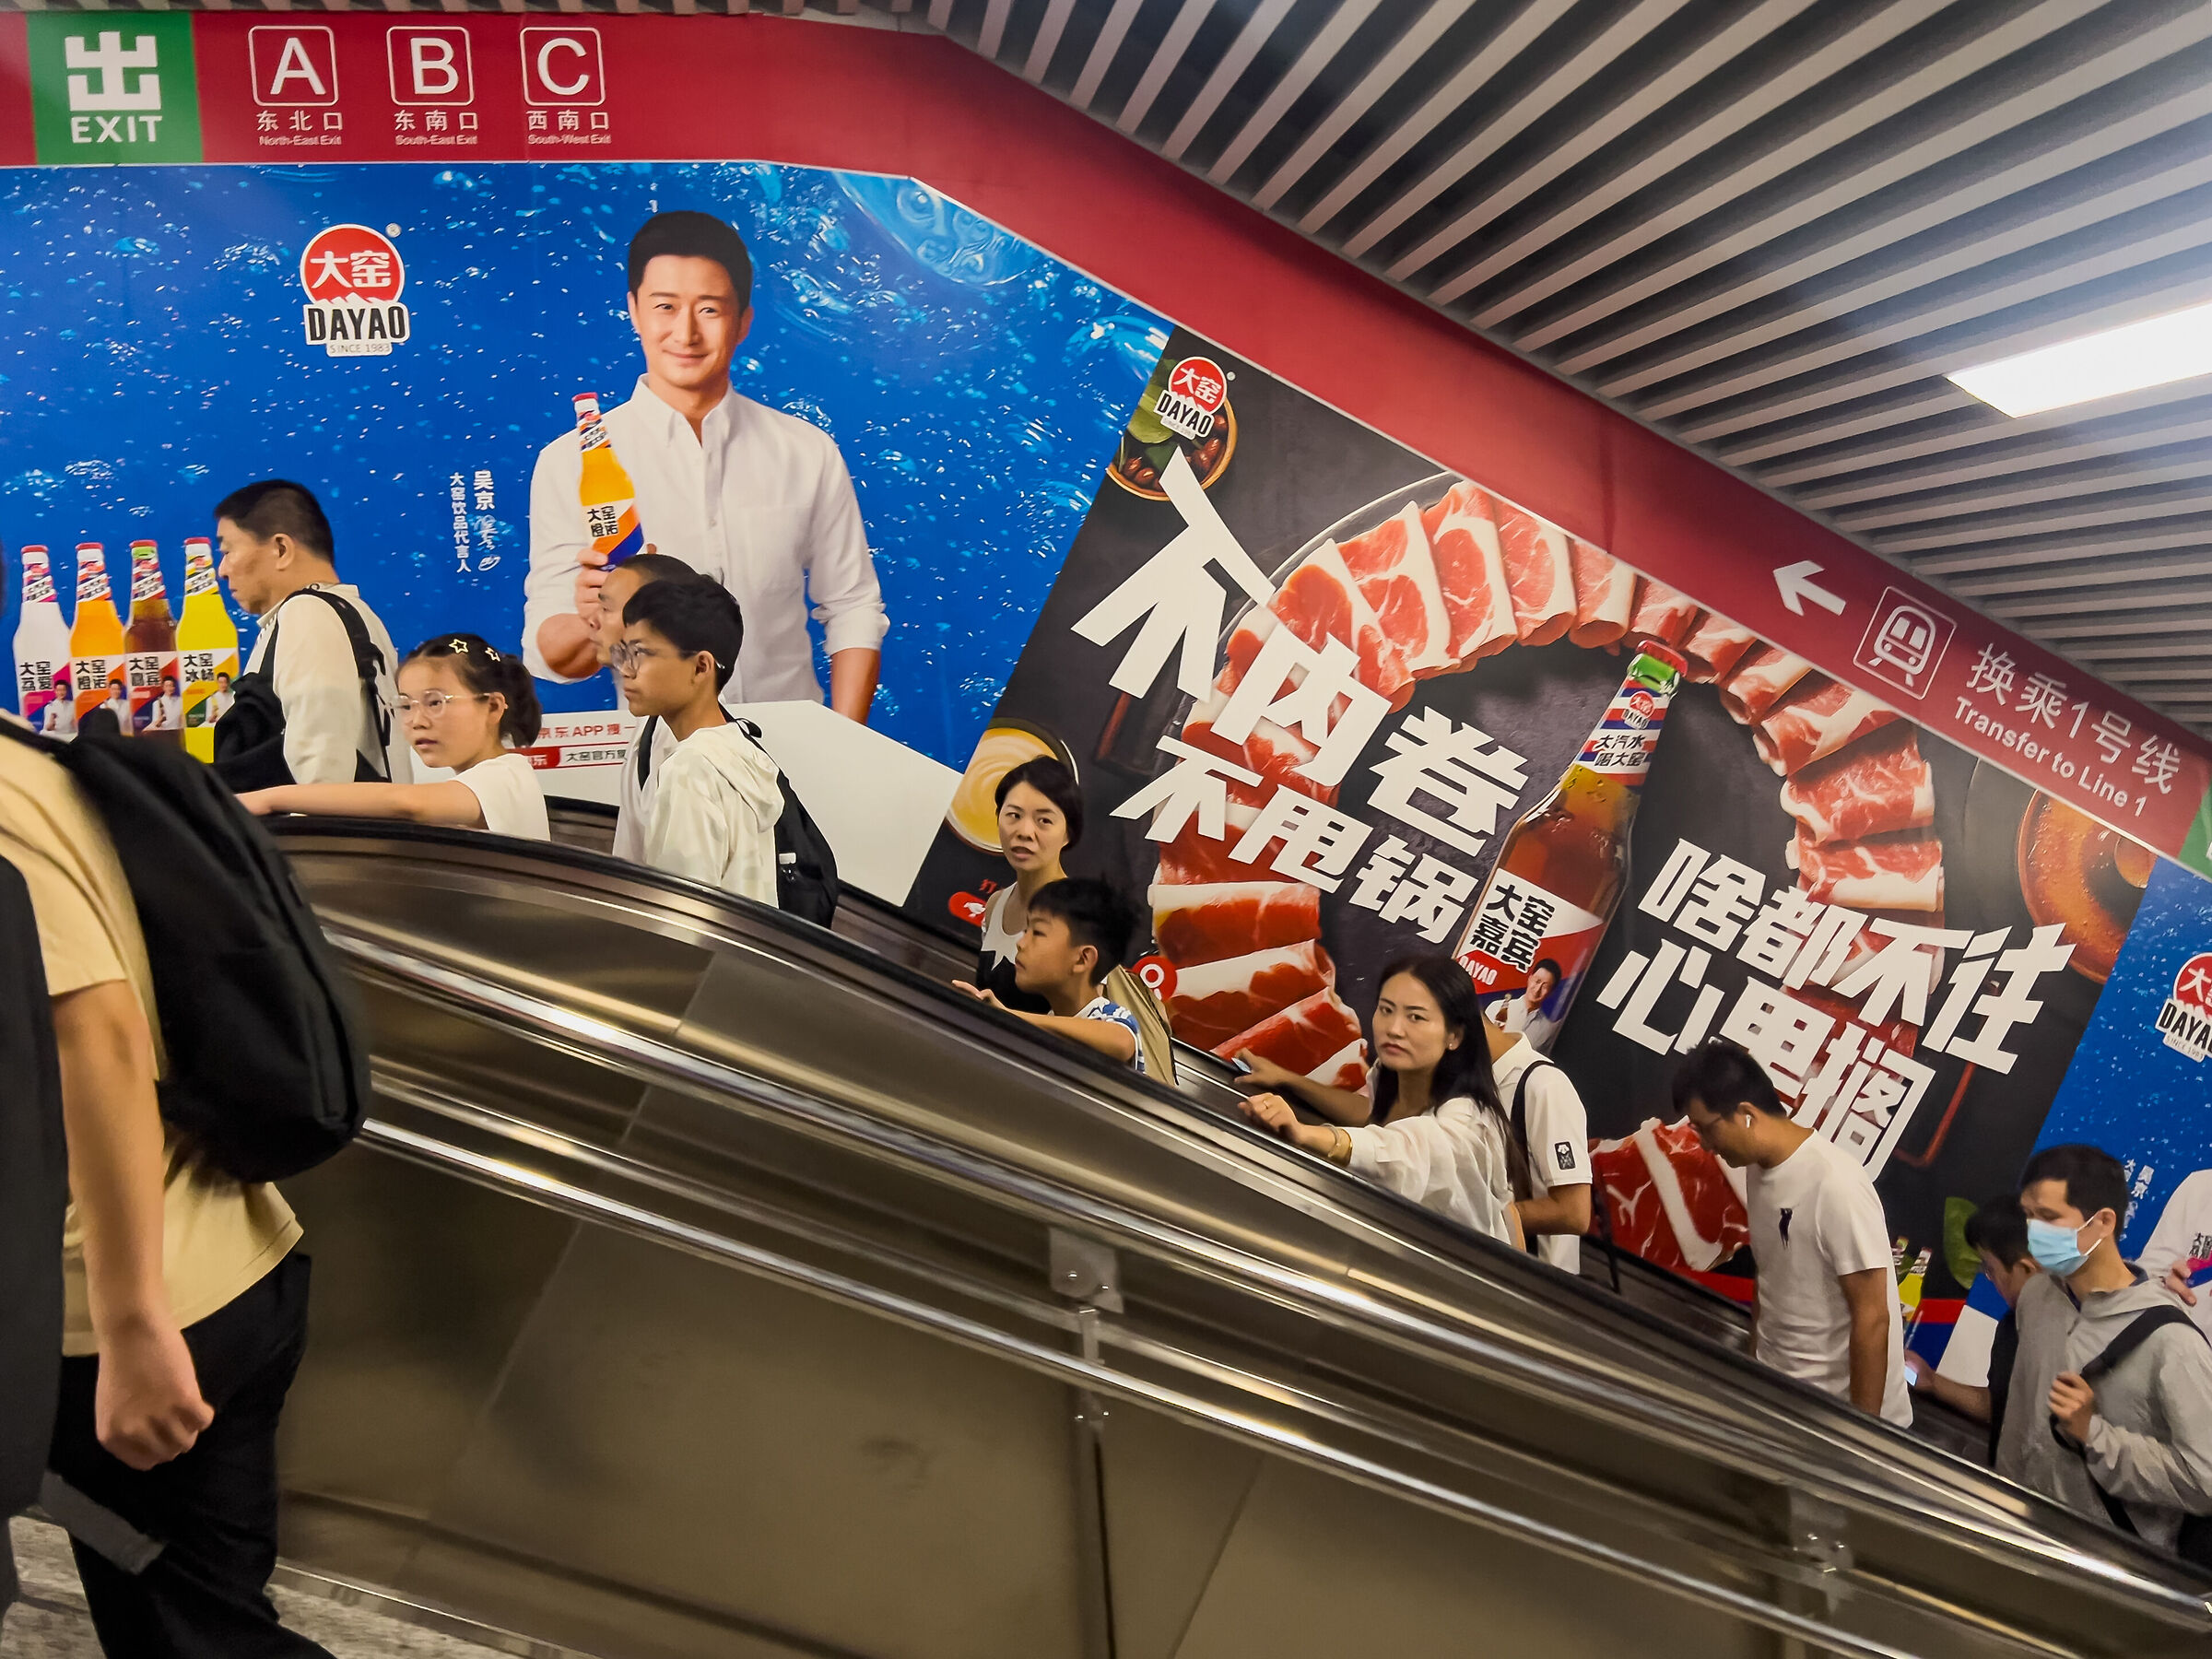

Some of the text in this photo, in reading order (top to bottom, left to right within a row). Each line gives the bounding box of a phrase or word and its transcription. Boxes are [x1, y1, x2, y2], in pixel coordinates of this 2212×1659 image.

[65, 31, 161, 111] 出
[270, 38, 325, 95] A
[412, 38, 459, 95] B
[537, 38, 589, 95] C
[70, 115, 162, 144] EXIT
[255, 111, 343, 132] 东北口
[259, 135, 342, 146] North-East Exit
[394, 111, 478, 132] 东南口
[395, 135, 477, 146] South-East Exit
[526, 111, 610, 132] 西南口
[528, 135, 611, 146] South-West Exit
[310, 250, 391, 288] 大窑
[308, 306, 406, 341] DAYAO
[330, 344, 390, 353] SINCE 1983
[1173, 368, 1221, 404] 大窑
[1157, 393, 1212, 435] DAYAO
[474, 470, 495, 511] 吴京
[450, 472, 471, 573] 大窑饮品代言人
[587, 506, 616, 523] 大窑
[1071, 446, 1528, 857] 不内卷
[572, 725, 604, 736] APP
[1623, 709, 1649, 728] DAYAO
[1966, 642, 2181, 794] 换乘1号线
[1594, 752, 1645, 767] 喝大窑
[1595, 735, 1645, 749] 大汽水
[1954, 696, 2147, 817] Transfer to Line 1
[1109, 735, 1477, 944] 不甩锅
[1486, 884, 1555, 936] 大窑
[1470, 913, 1538, 971] 嘉宾
[1638, 838, 2077, 1076] 啥都不往
[1459, 956, 1498, 985] DAYAO
[2179, 968, 2212, 1007] 大
[2159, 1003, 2212, 1053] DAYA
